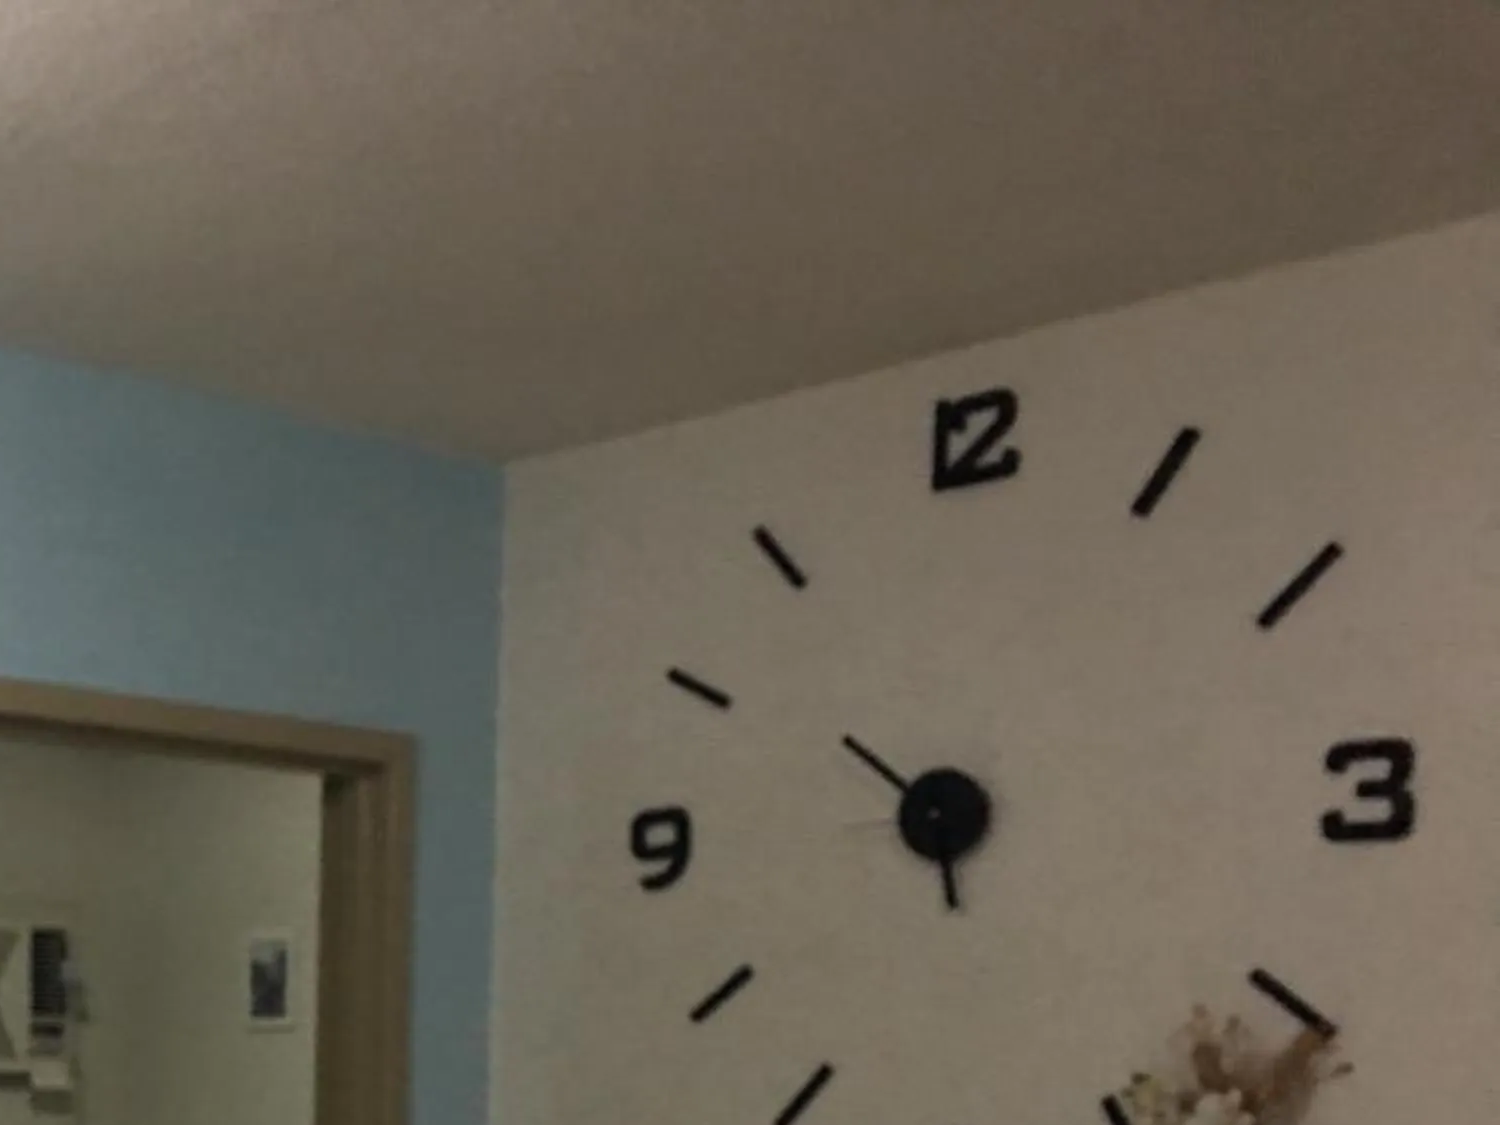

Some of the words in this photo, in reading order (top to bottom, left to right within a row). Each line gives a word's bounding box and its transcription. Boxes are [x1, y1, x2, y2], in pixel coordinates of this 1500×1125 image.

[932, 389, 1021, 491] 12
[1321, 739, 1414, 842] 3
[630, 806, 691, 891] 9
